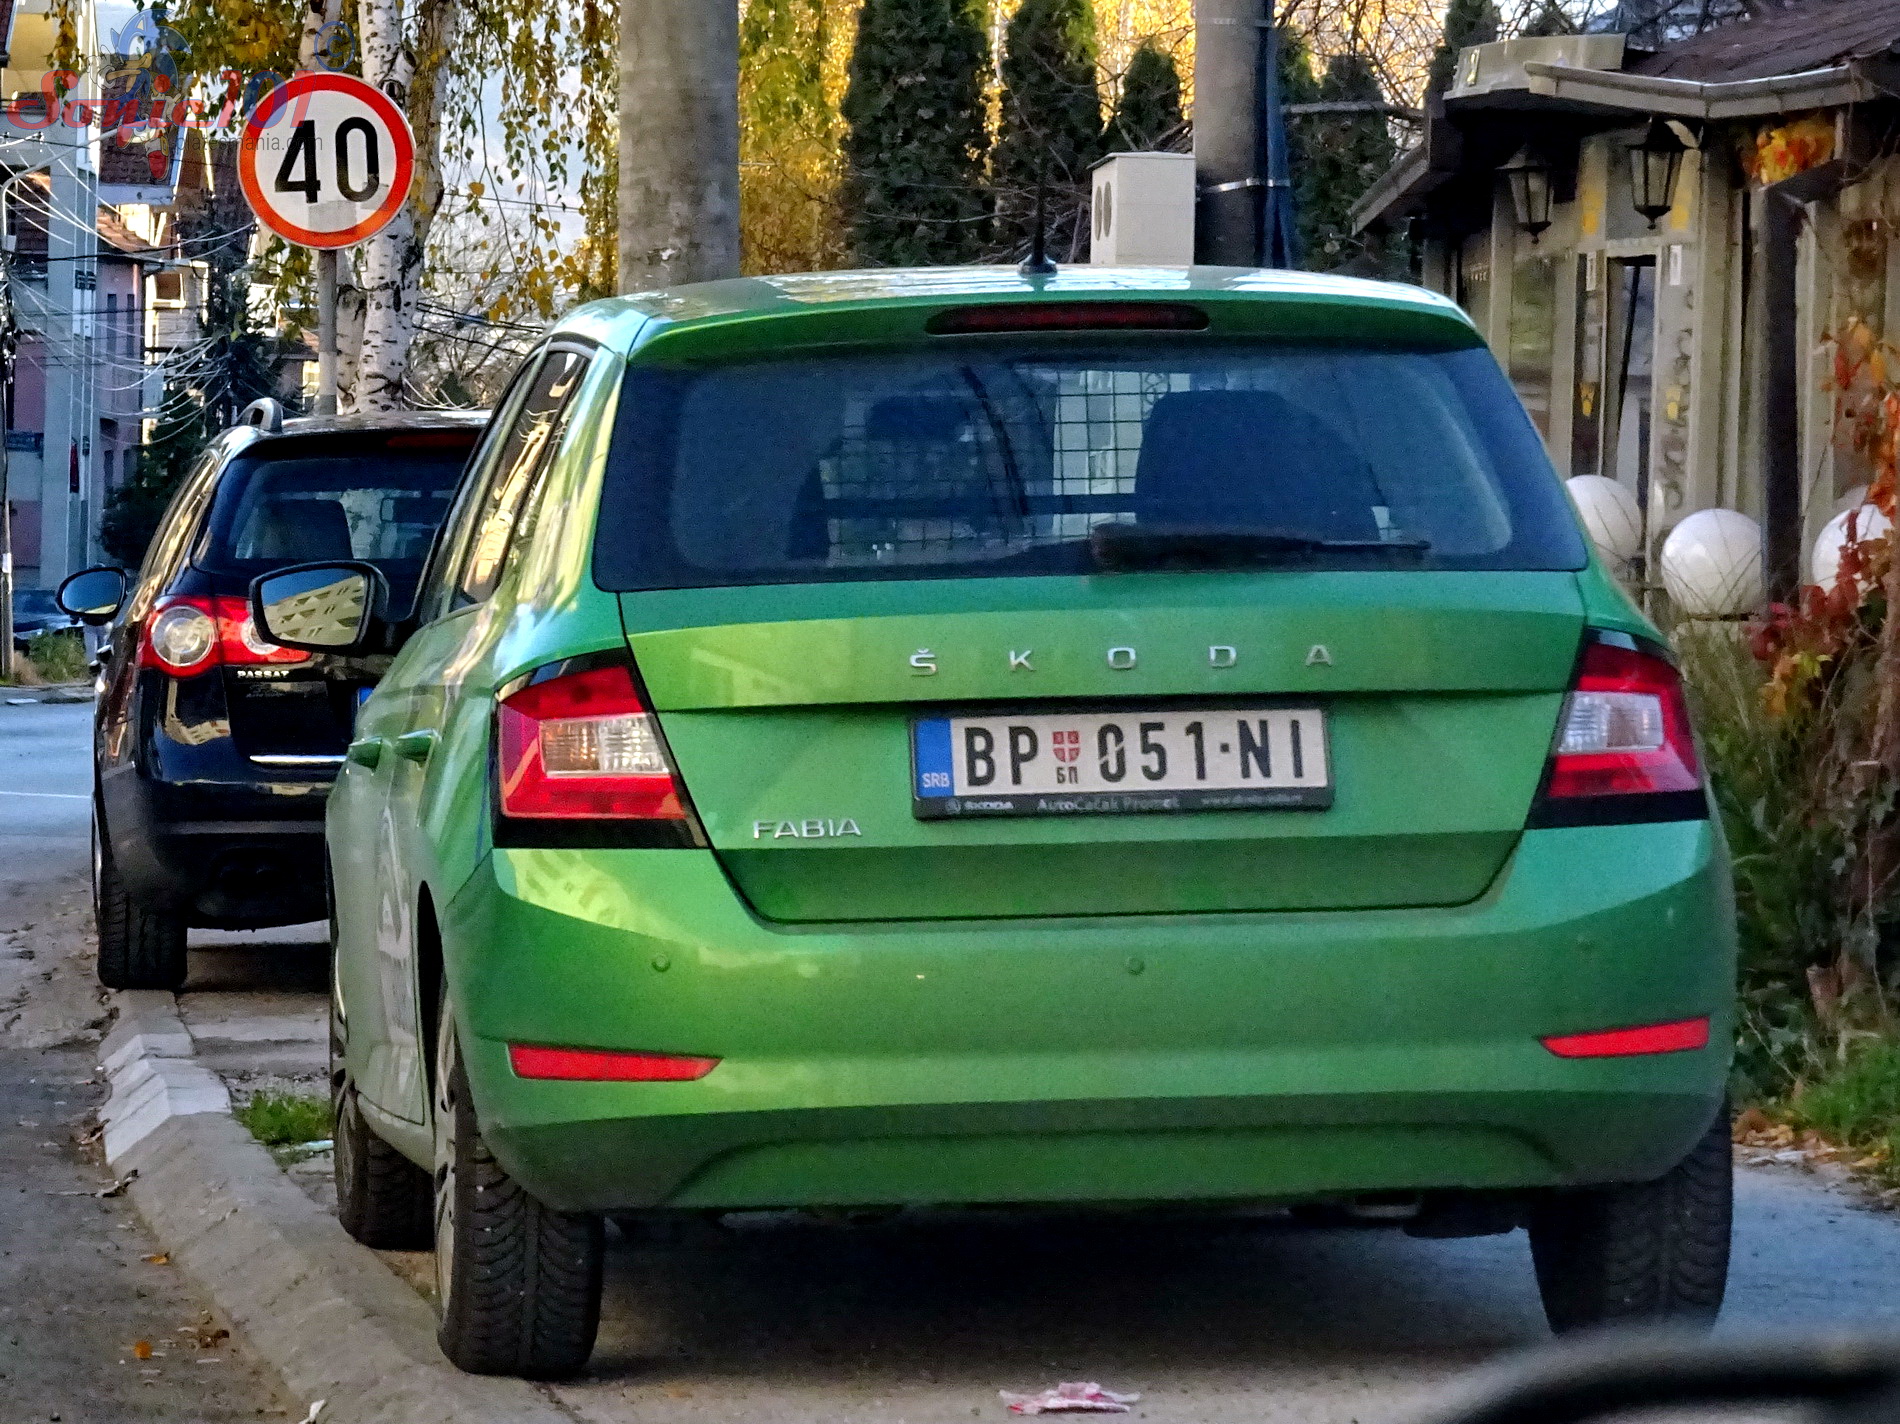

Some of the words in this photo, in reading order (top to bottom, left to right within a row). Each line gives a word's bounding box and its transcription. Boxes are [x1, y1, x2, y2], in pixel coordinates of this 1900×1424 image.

[274, 116, 380, 204] 40
[909, 645, 1335, 677] ŠKODA
[237, 670, 290, 679] PASSAT
[964, 725, 1039, 787] BP
[922, 772, 950, 788] SRB
[753, 818, 862, 839] FABIA
